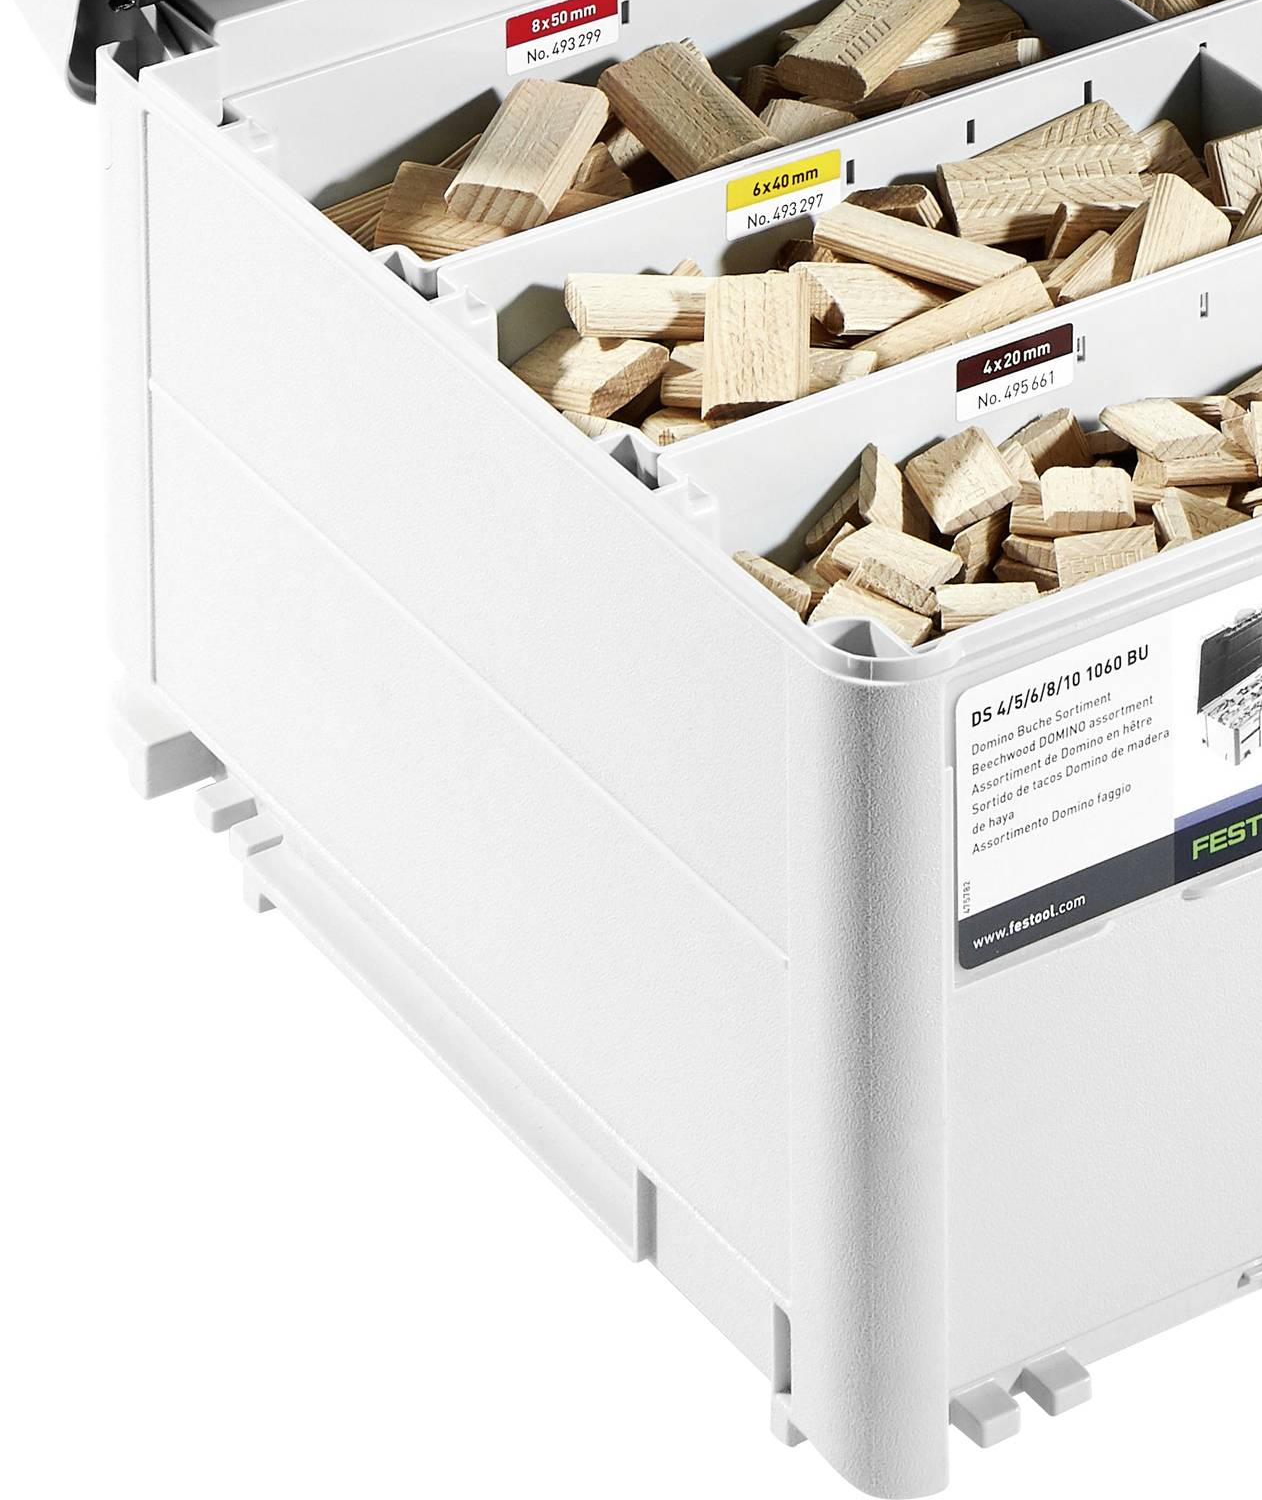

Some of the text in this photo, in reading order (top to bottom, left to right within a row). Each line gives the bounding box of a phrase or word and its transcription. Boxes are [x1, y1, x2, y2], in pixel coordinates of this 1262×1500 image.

[527, 49, 549, 64] No.
[748, 214, 770, 229] No.
[978, 393, 1001, 409] No.
[972, 645, 1148, 727] DS 4/5/6/8/10 1060 BU
[972, 692, 1110, 755] Domino Buche Sortiment
[972, 696, 1152, 775] Beechwood DOMINO assortment
[972, 717, 1152, 795] Assortiment de Domino en hêtre
[972, 730, 1169, 815] Sortido de tacos Domino de madera
[972, 784, 1131, 854] Assortimento Domino faggio
[973, 812, 1014, 834] de haya
[973, 896, 1085, 948] www.festool.com
